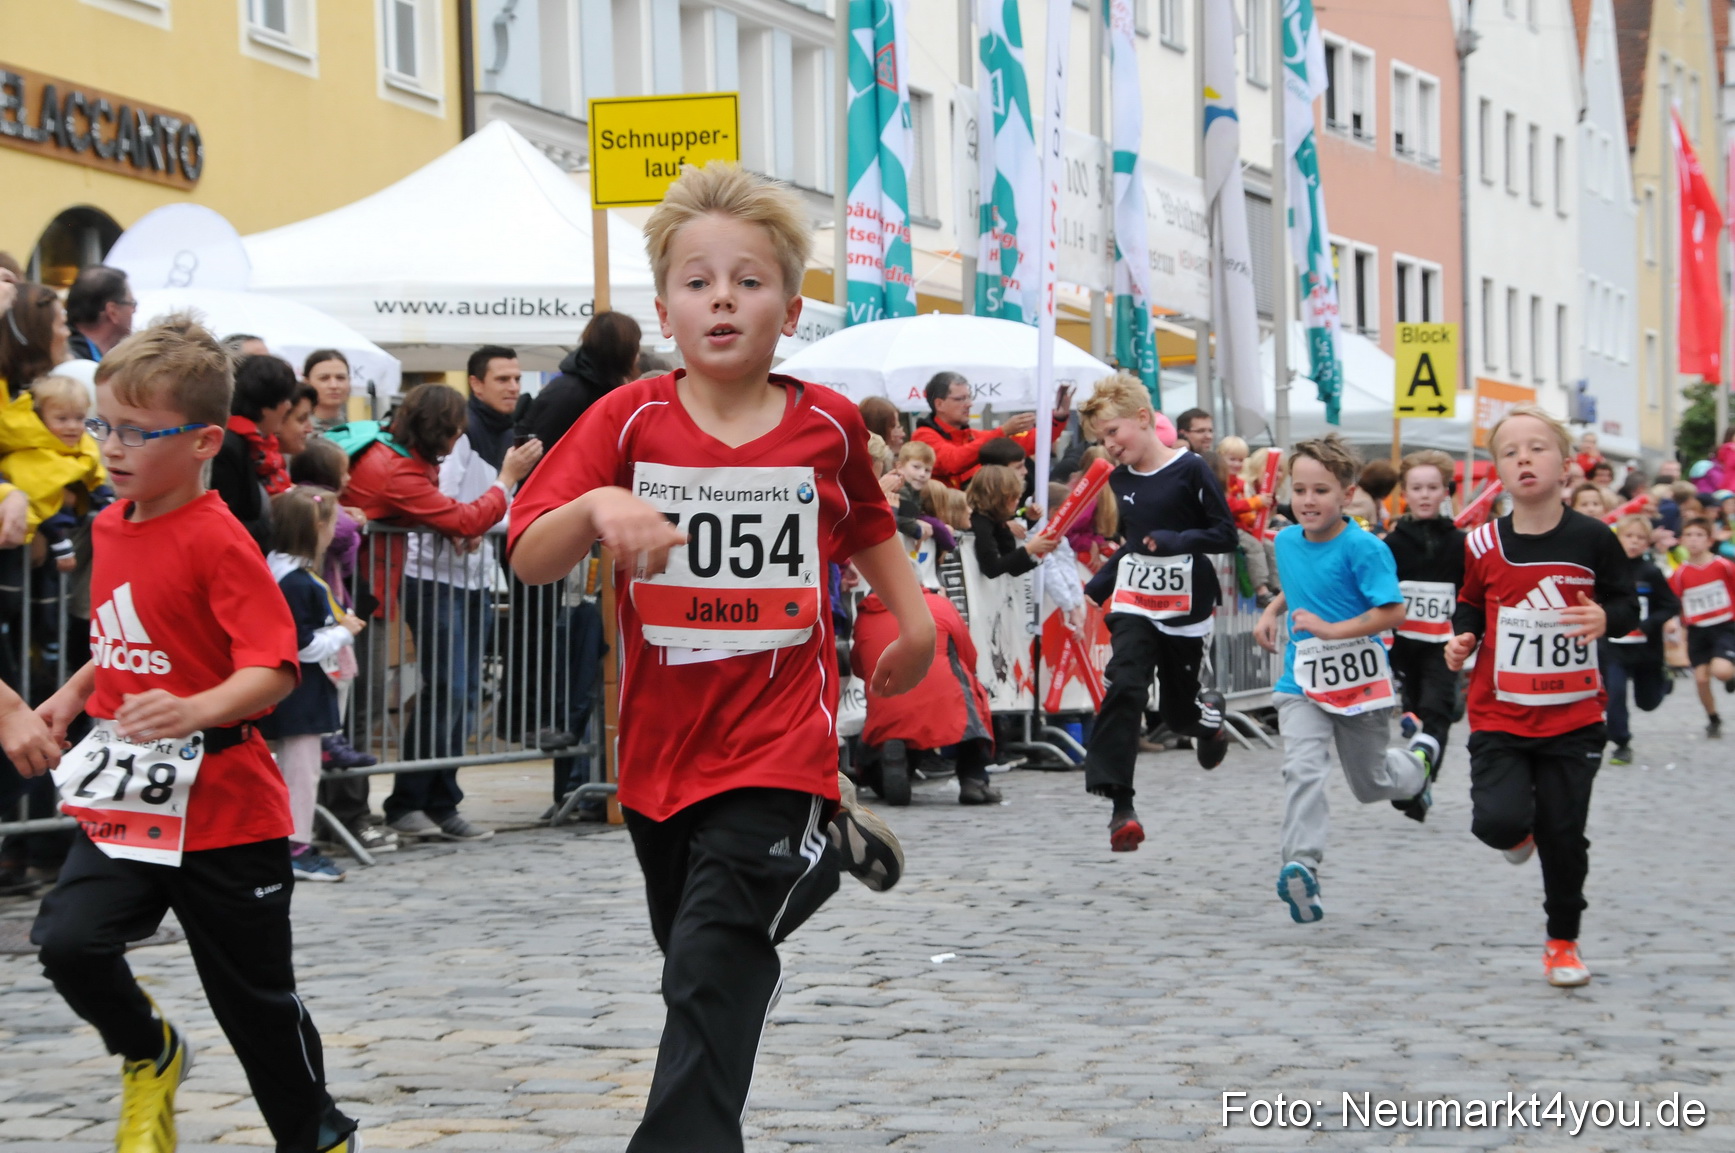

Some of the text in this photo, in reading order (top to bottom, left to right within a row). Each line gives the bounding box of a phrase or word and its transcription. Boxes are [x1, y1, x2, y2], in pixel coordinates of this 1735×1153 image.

[601, 129, 729, 151] Schnupper-
[1401, 327, 1450, 344] Block
[1407, 352, 1441, 397] A
[639, 481, 790, 502] PARTL Neumarkt
[1126, 561, 1185, 591] 7235
[685, 597, 759, 623] Jakob
[1403, 596, 1450, 619] 7564
[1508, 632, 1589, 668] 7189
[1303, 648, 1378, 688] 7580
[1532, 678, 1565, 691] Luca
